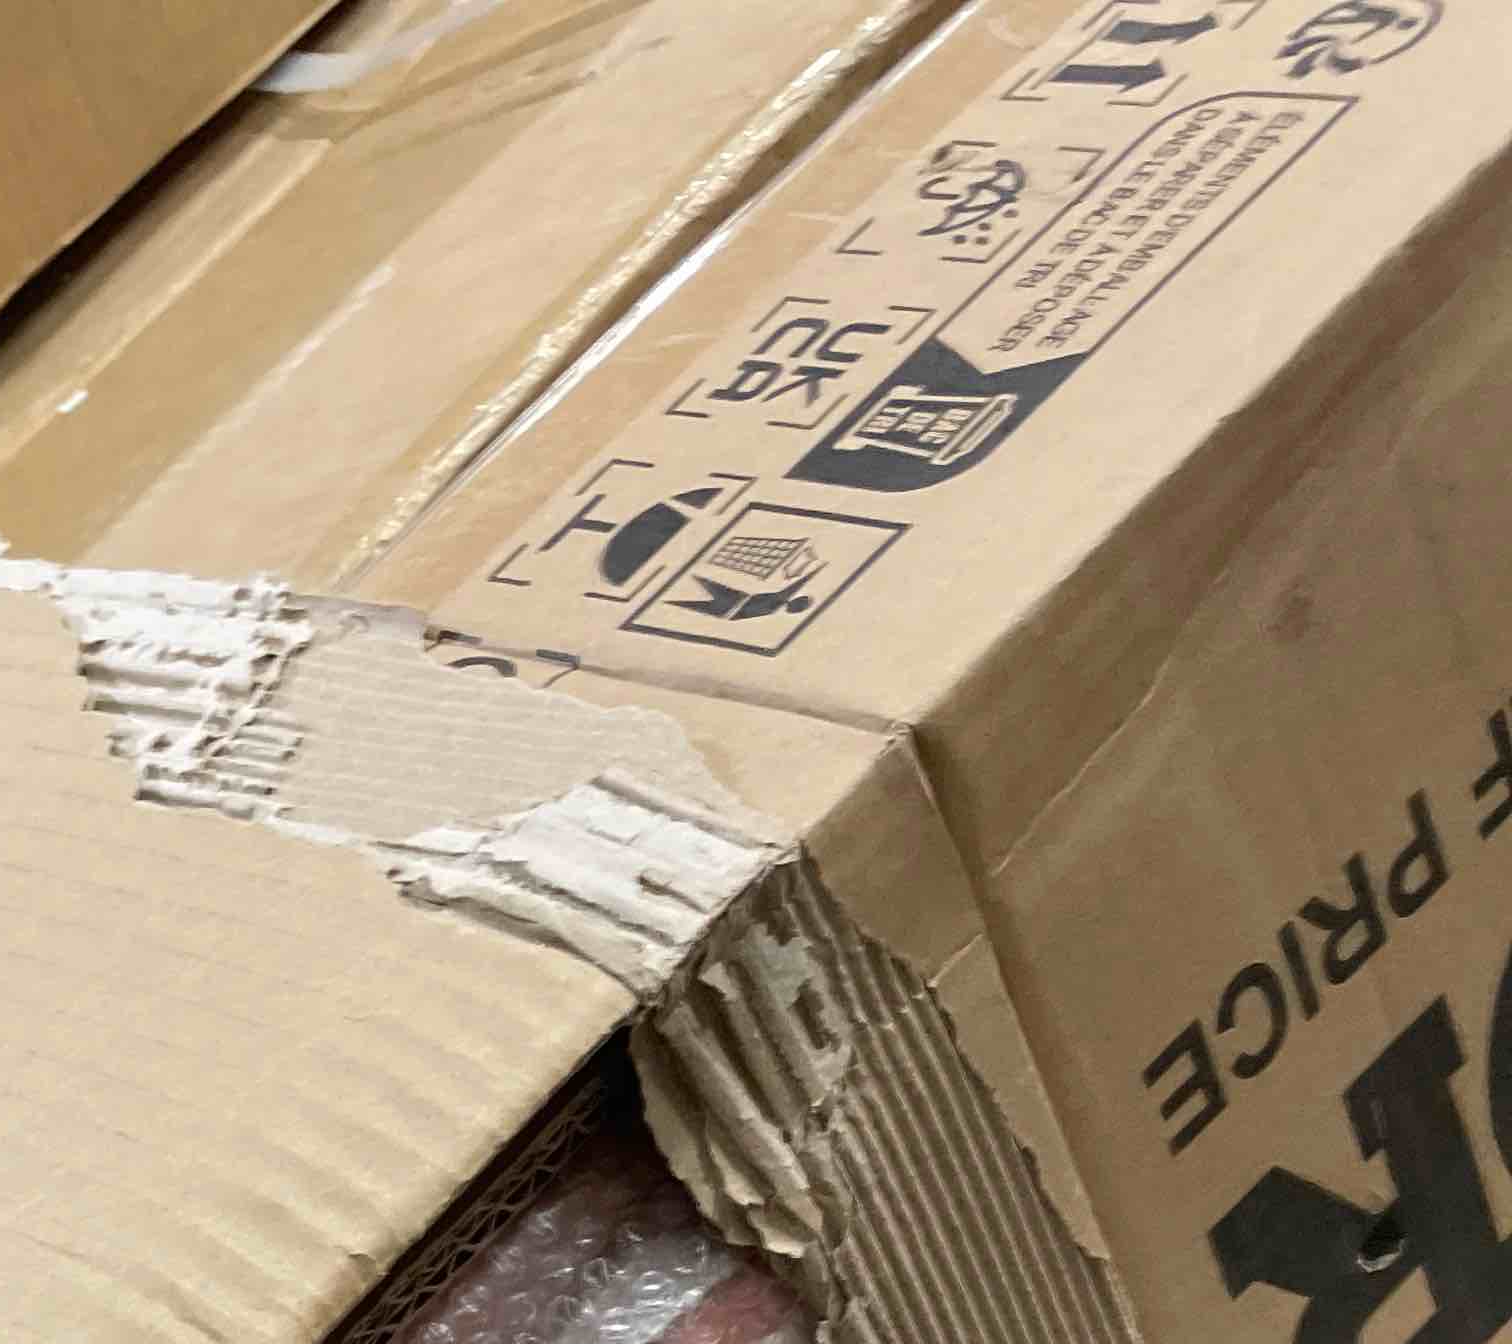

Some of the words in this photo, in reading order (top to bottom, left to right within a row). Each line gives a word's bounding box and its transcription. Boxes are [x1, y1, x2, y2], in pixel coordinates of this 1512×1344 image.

[1153, 109, 1221, 159] DANS
[1123, 160, 1166, 184] LE
[1079, 186, 1138, 226] BAC
[1049, 229, 1091, 255] DE
[1111, 214, 1150, 241] ET
[1015, 259, 1064, 288] TRI
[707, 316, 831, 402] CA
[761, 321, 892, 408] UK
[1141, 790, 1452, 1157] PRICE
